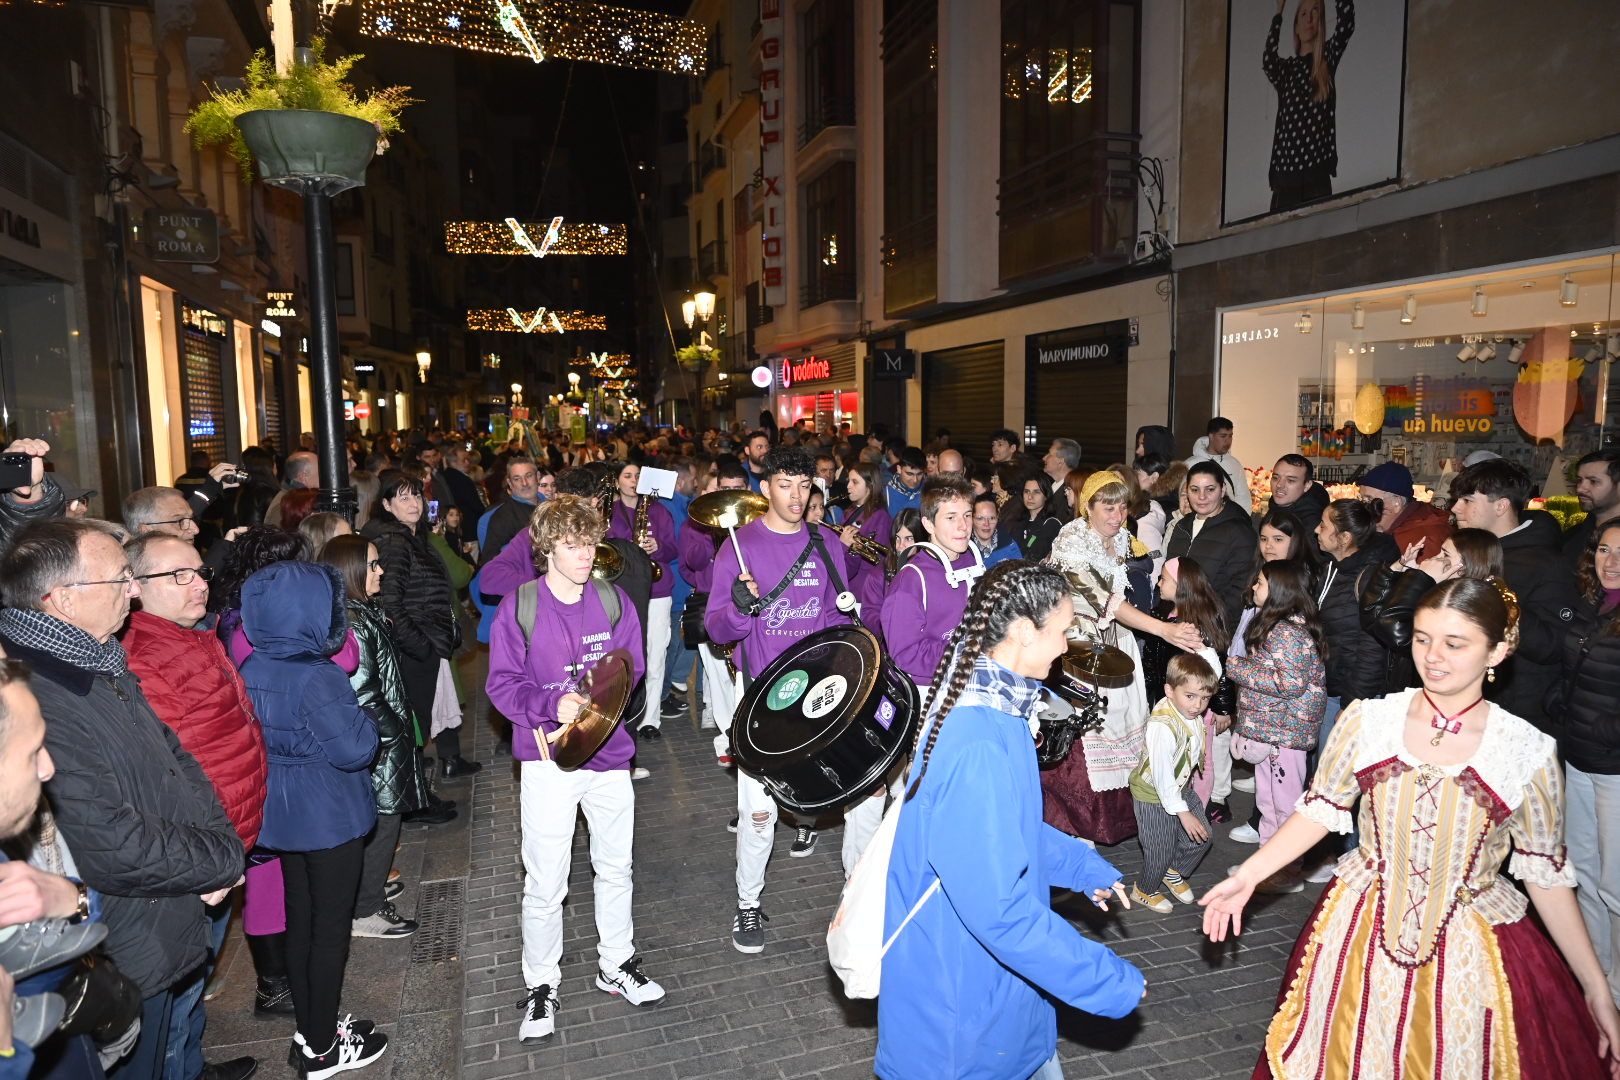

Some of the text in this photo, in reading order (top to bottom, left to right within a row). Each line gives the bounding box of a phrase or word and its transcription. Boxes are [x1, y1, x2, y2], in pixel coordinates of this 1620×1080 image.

[159, 215, 202, 228] PUNT
[158, 240, 206, 253] ROMA
[267, 292, 294, 300] PUNT
[266, 307, 296, 317] ROMA
[1039, 343, 1109, 364] MARVIMUNDO
[792, 356, 830, 382] vodafone
[1404, 413, 1492, 433] un huevo
[786, 560, 803, 581] MAX
[801, 570, 812, 578] LOS
[582, 631, 611, 645] XARANGA
[590, 643, 603, 652] LOS
